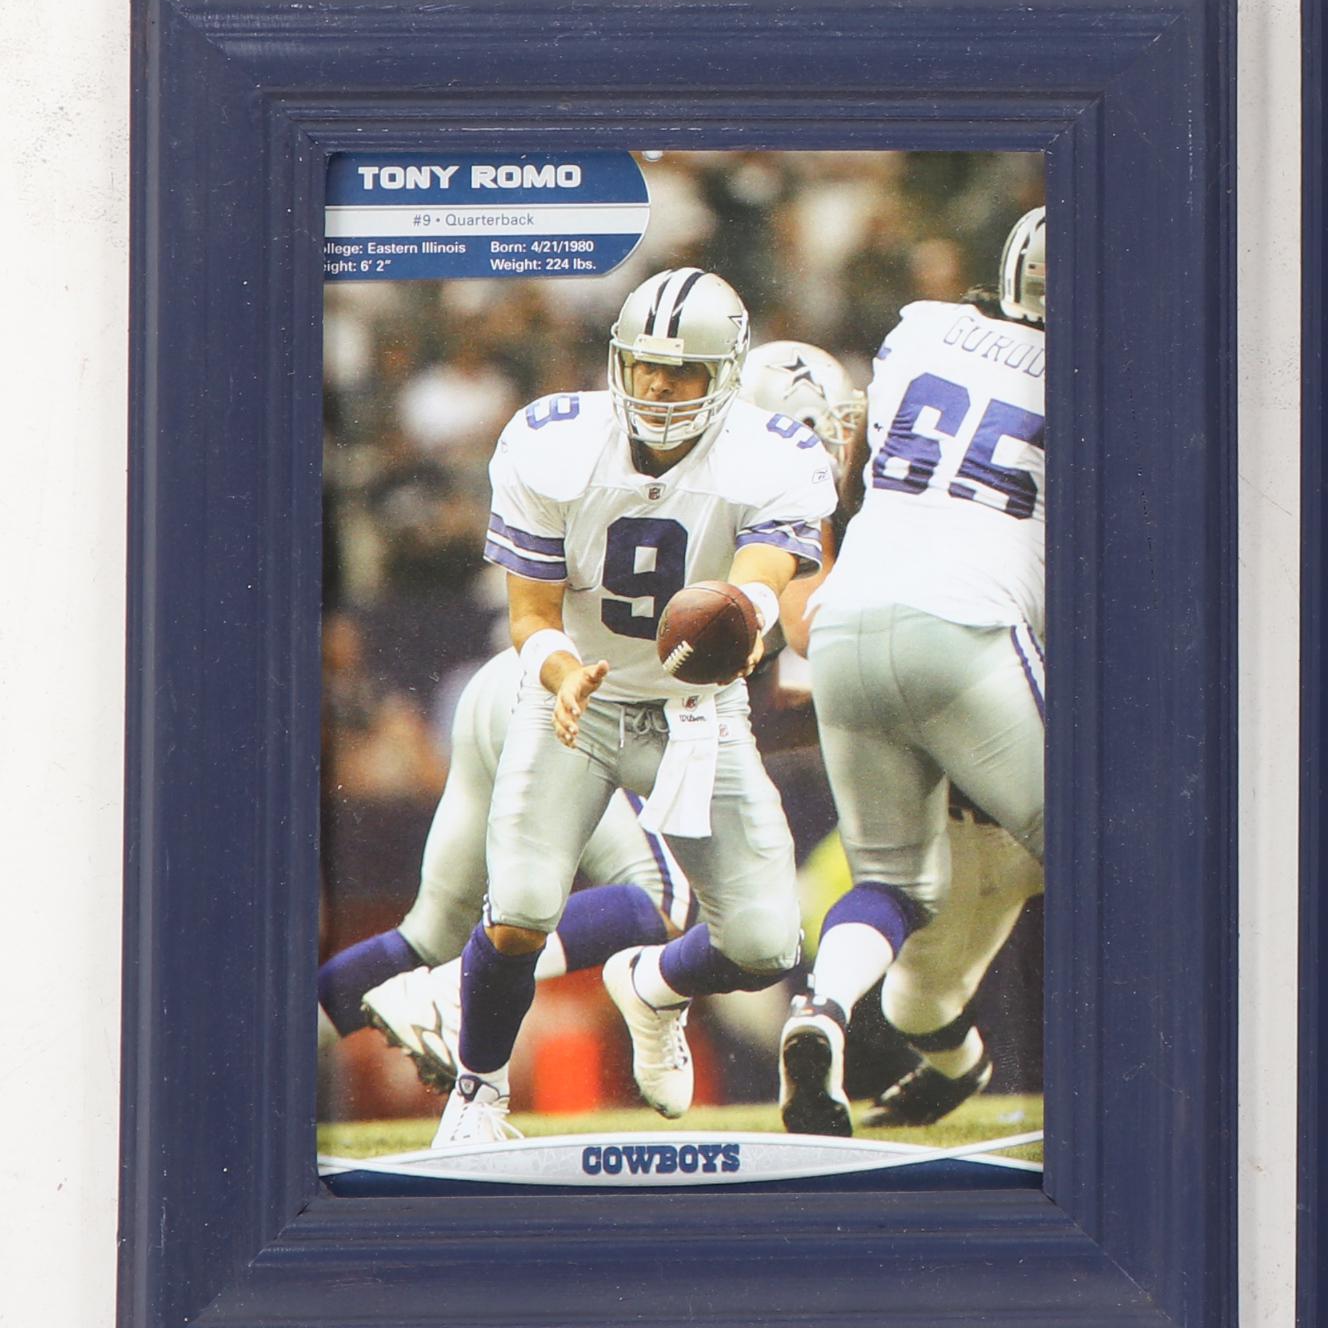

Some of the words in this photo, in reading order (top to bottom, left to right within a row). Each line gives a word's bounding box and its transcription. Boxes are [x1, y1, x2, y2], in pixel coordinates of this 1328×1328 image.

[358, 165, 460, 190] TONY
[471, 164, 582, 189] ROMO
[413, 214, 431, 226] #9
[445, 213, 535, 227] Quarterback
[324, 242, 363, 256] llege:
[367, 242, 418, 254] Eastern
[422, 241, 466, 254] Illinois
[490, 241, 527, 253] Born:
[531, 240, 594, 253] 4/21/1980
[490, 259, 542, 272] Weight:
[545, 258, 569, 270] 224
[573, 258, 597, 270] lbs.
[872, 372, 1045, 520] 65
[601, 516, 688, 641] 9
[582, 1144, 741, 1175] COWBOYS
